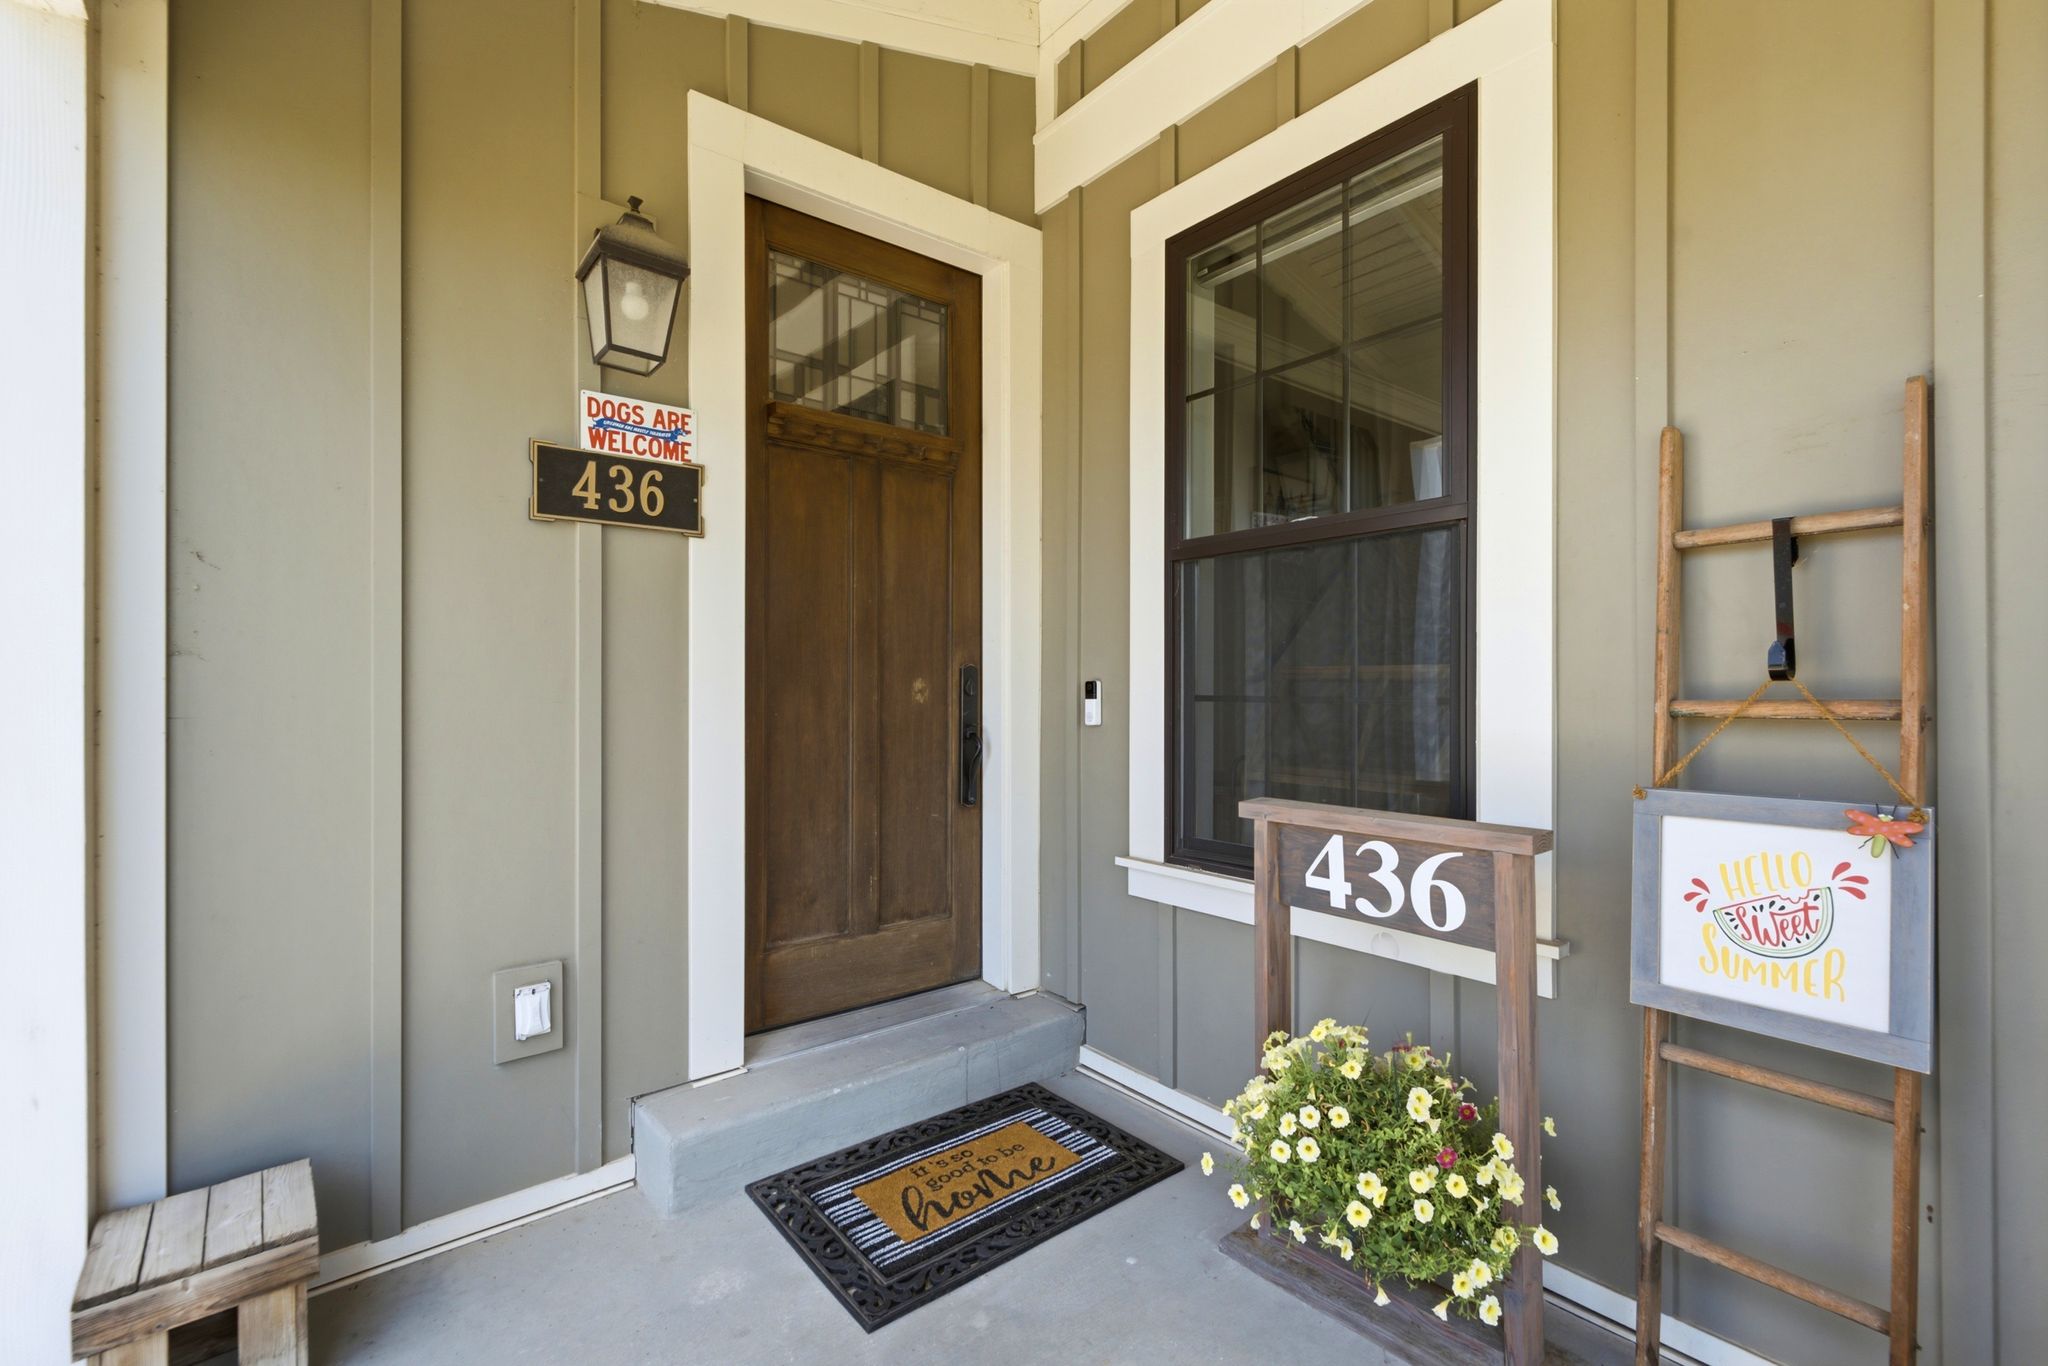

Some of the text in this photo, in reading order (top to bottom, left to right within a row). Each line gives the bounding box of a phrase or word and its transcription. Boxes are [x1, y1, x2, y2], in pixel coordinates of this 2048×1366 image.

[587, 396, 645, 426] DOGS
[653, 409, 692, 435] ARE
[588, 426, 692, 463] WELCOME
[572, 460, 665, 517] 436
[1305, 834, 1466, 932] 436
[1719, 851, 1812, 900] HELLO
[1699, 921, 1846, 1002] SUMMER
[910, 1149, 974, 1179] it's so
[925, 1143, 1025, 1192] good to be
[901, 1156, 1056, 1231] home
